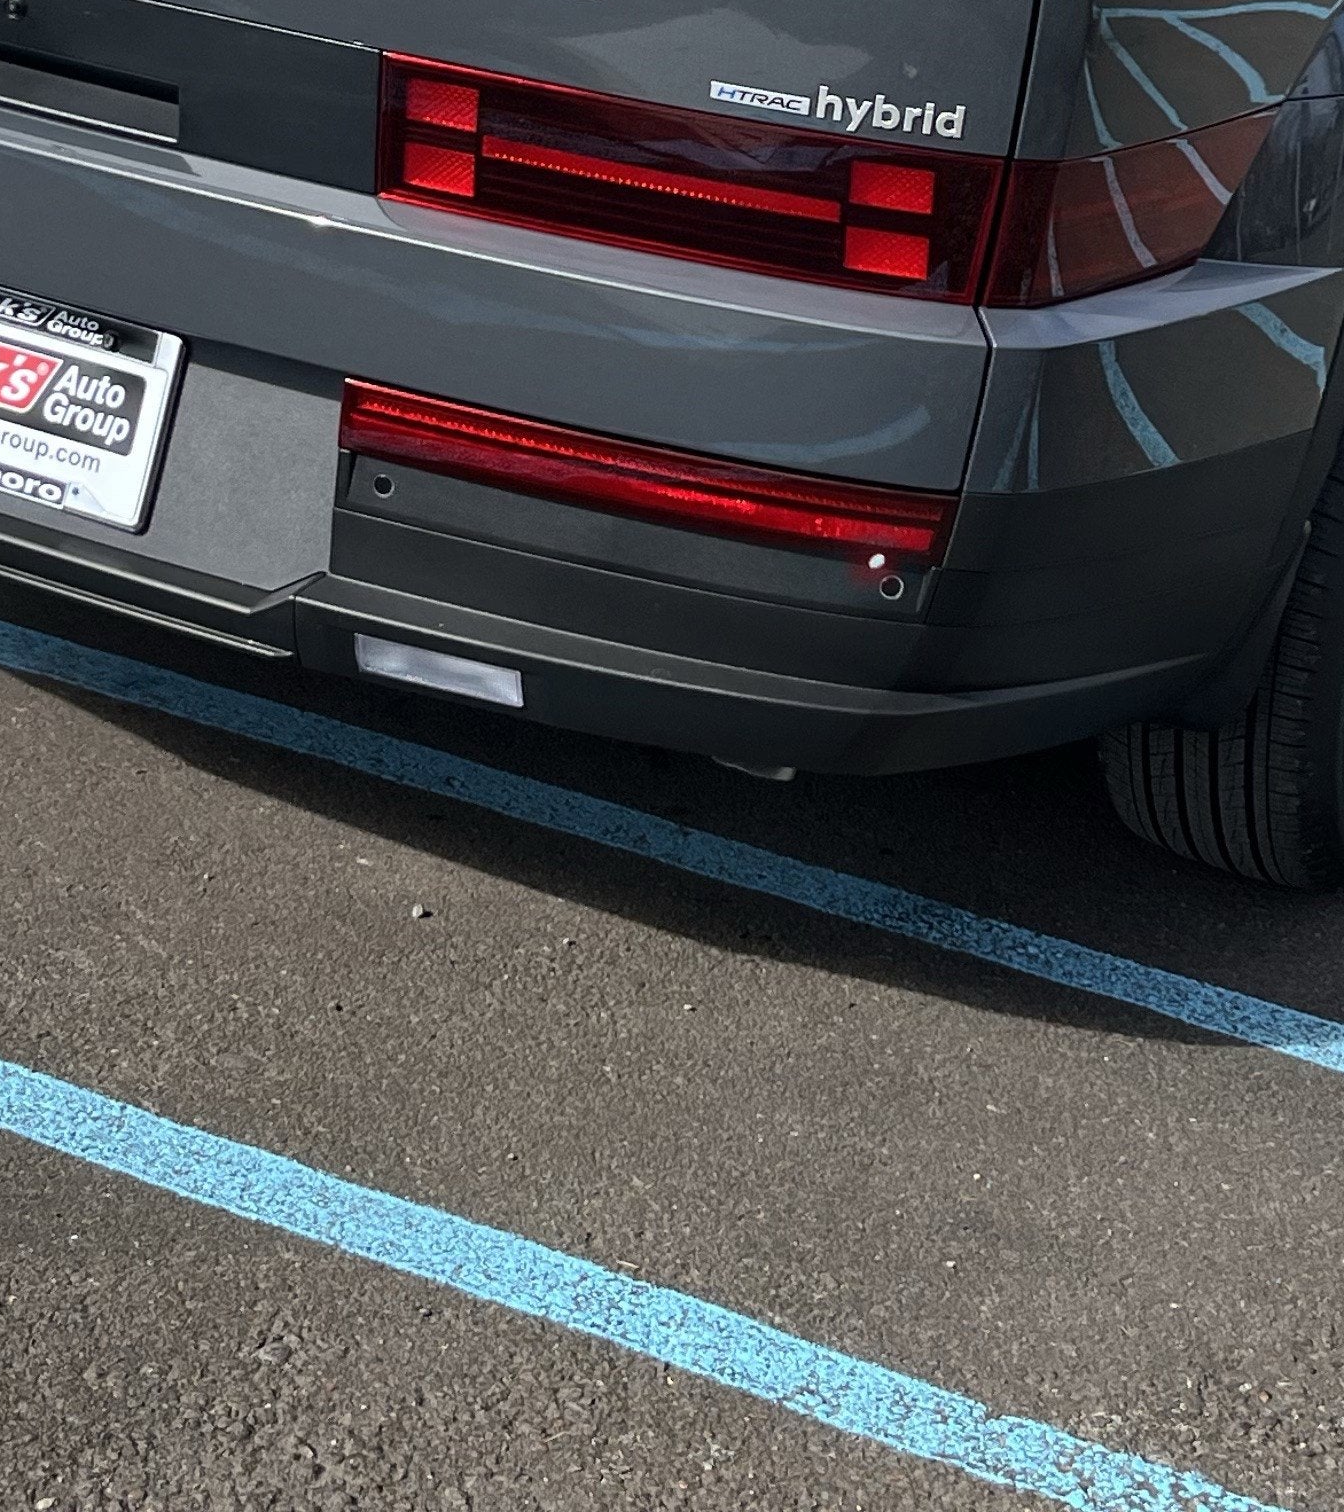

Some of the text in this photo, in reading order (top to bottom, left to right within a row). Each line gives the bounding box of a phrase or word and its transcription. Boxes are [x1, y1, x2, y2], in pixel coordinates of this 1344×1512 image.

[715, 85, 966, 138] HTRAC hybrid
[47, 320, 105, 347] Group
[53, 310, 100, 331] Auto
[53, 364, 126, 408] Auto
[43, 392, 130, 446] Group
